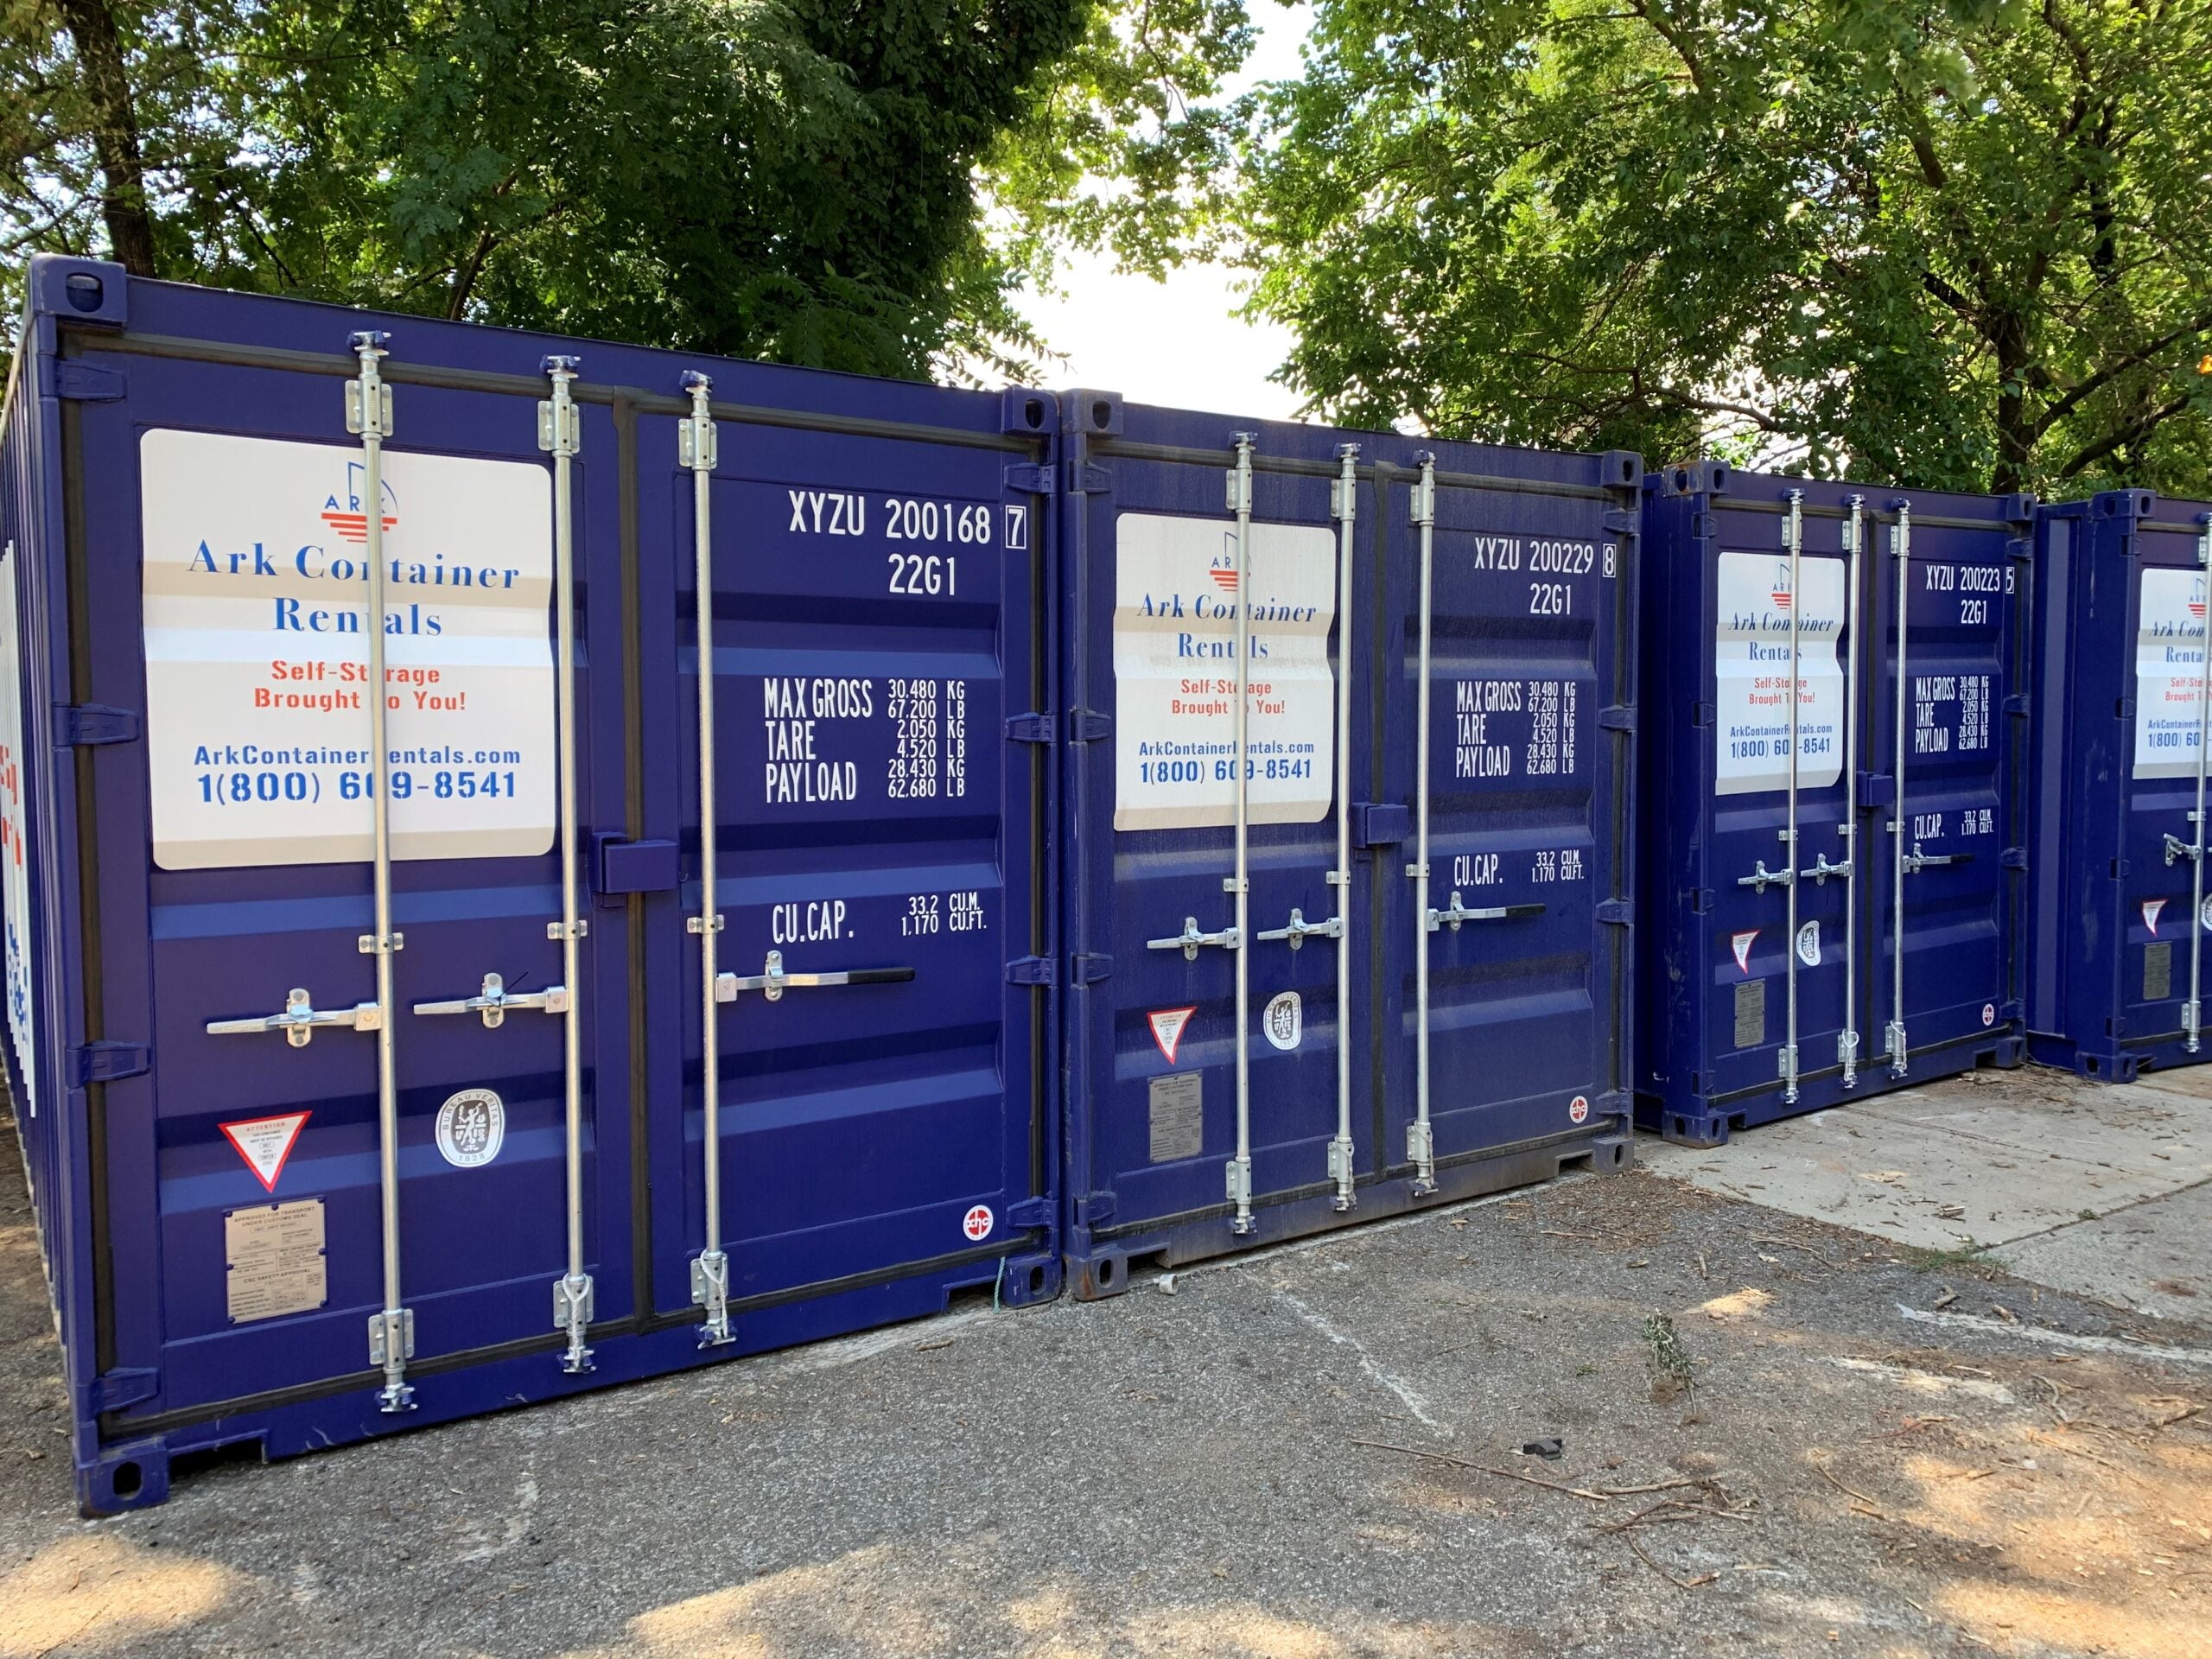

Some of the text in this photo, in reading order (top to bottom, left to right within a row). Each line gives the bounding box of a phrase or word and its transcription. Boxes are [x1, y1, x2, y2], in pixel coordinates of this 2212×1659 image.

[789, 490, 1024, 546] XYZU 200168 7
[188, 539, 276, 576] Ark
[1474, 537, 1520, 570] XYZU
[1529, 540, 1594, 574] 200229
[888, 553, 955, 595] 22G1
[1926, 565, 1954, 590] XYZU
[1960, 567, 1999, 591] 200223
[1138, 592, 1185, 619] Ark
[1529, 582, 1571, 614] 22G1
[273, 596, 442, 636] Renals
[1728, 612, 1834, 632] Ark Conainer
[1961, 600, 1986, 624] 22G1
[2148, 620, 2173, 637] Ark
[1178, 632, 1268, 658] Rentls
[1750, 641, 1802, 661] Rentas
[2166, 645, 2204, 663] Renta
[270, 660, 441, 686] Self-Strage
[1755, 677, 1808, 690] Self-Stoge
[255, 688, 360, 712] Brought
[413, 691, 466, 710] You!
[764, 677, 806, 718] MAX
[812, 678, 873, 718] GROSS
[947, 680, 965, 700] KG
[1181, 679, 1272, 696] Self-Stage
[1456, 681, 1482, 712] MAX
[1485, 681, 1521, 712] GROSS
[1564, 681, 1576, 697] KG
[1749, 692, 1782, 706] Brought
[1798, 691, 1815, 702] You!
[1916, 677, 1931, 702] MAX
[1933, 677, 1955, 701] GROSS
[1981, 676, 1989, 688] KG
[2165, 691, 2195, 702] Brought
[947, 700, 965, 720] LB
[1172, 700, 1228, 716] Brought
[1256, 700, 1285, 714] You!
[1563, 696, 1575, 713] LB
[1916, 702, 1935, 728] TARE
[1980, 700, 1989, 712] KG
[766, 720, 816, 760] TARE
[947, 720, 965, 739] KG
[1457, 714, 1487, 745] TARE
[1563, 712, 1575, 728] KG
[1562, 728, 1574, 743] LB
[1916, 728, 1948, 753] PAYLOAD
[1980, 724, 1988, 736] KG
[2148, 732, 2182, 748] 1(800)
[194, 745, 520, 766] ArkContainerentals.com
[947, 739, 965, 758] LB
[1456, 746, 1510, 778] PAYLOAD
[1562, 743, 1574, 759] KG
[1731, 738, 1830, 760] 1(800) 60-8541
[1141, 761, 1205, 785] 1(800)
[1562, 759, 1573, 774] LB
[198, 772, 321, 805] 1(800)
[766, 761, 856, 803] PAYLOAD
[947, 758, 965, 778] KG
[947, 778, 965, 797] LB
[1536, 851, 1555, 867] 33.2
[772, 899, 855, 944] CU.CAP.
[908, 895, 938, 916] 33.2
[442, 1092, 499, 1130] BUREAU VERITAS
